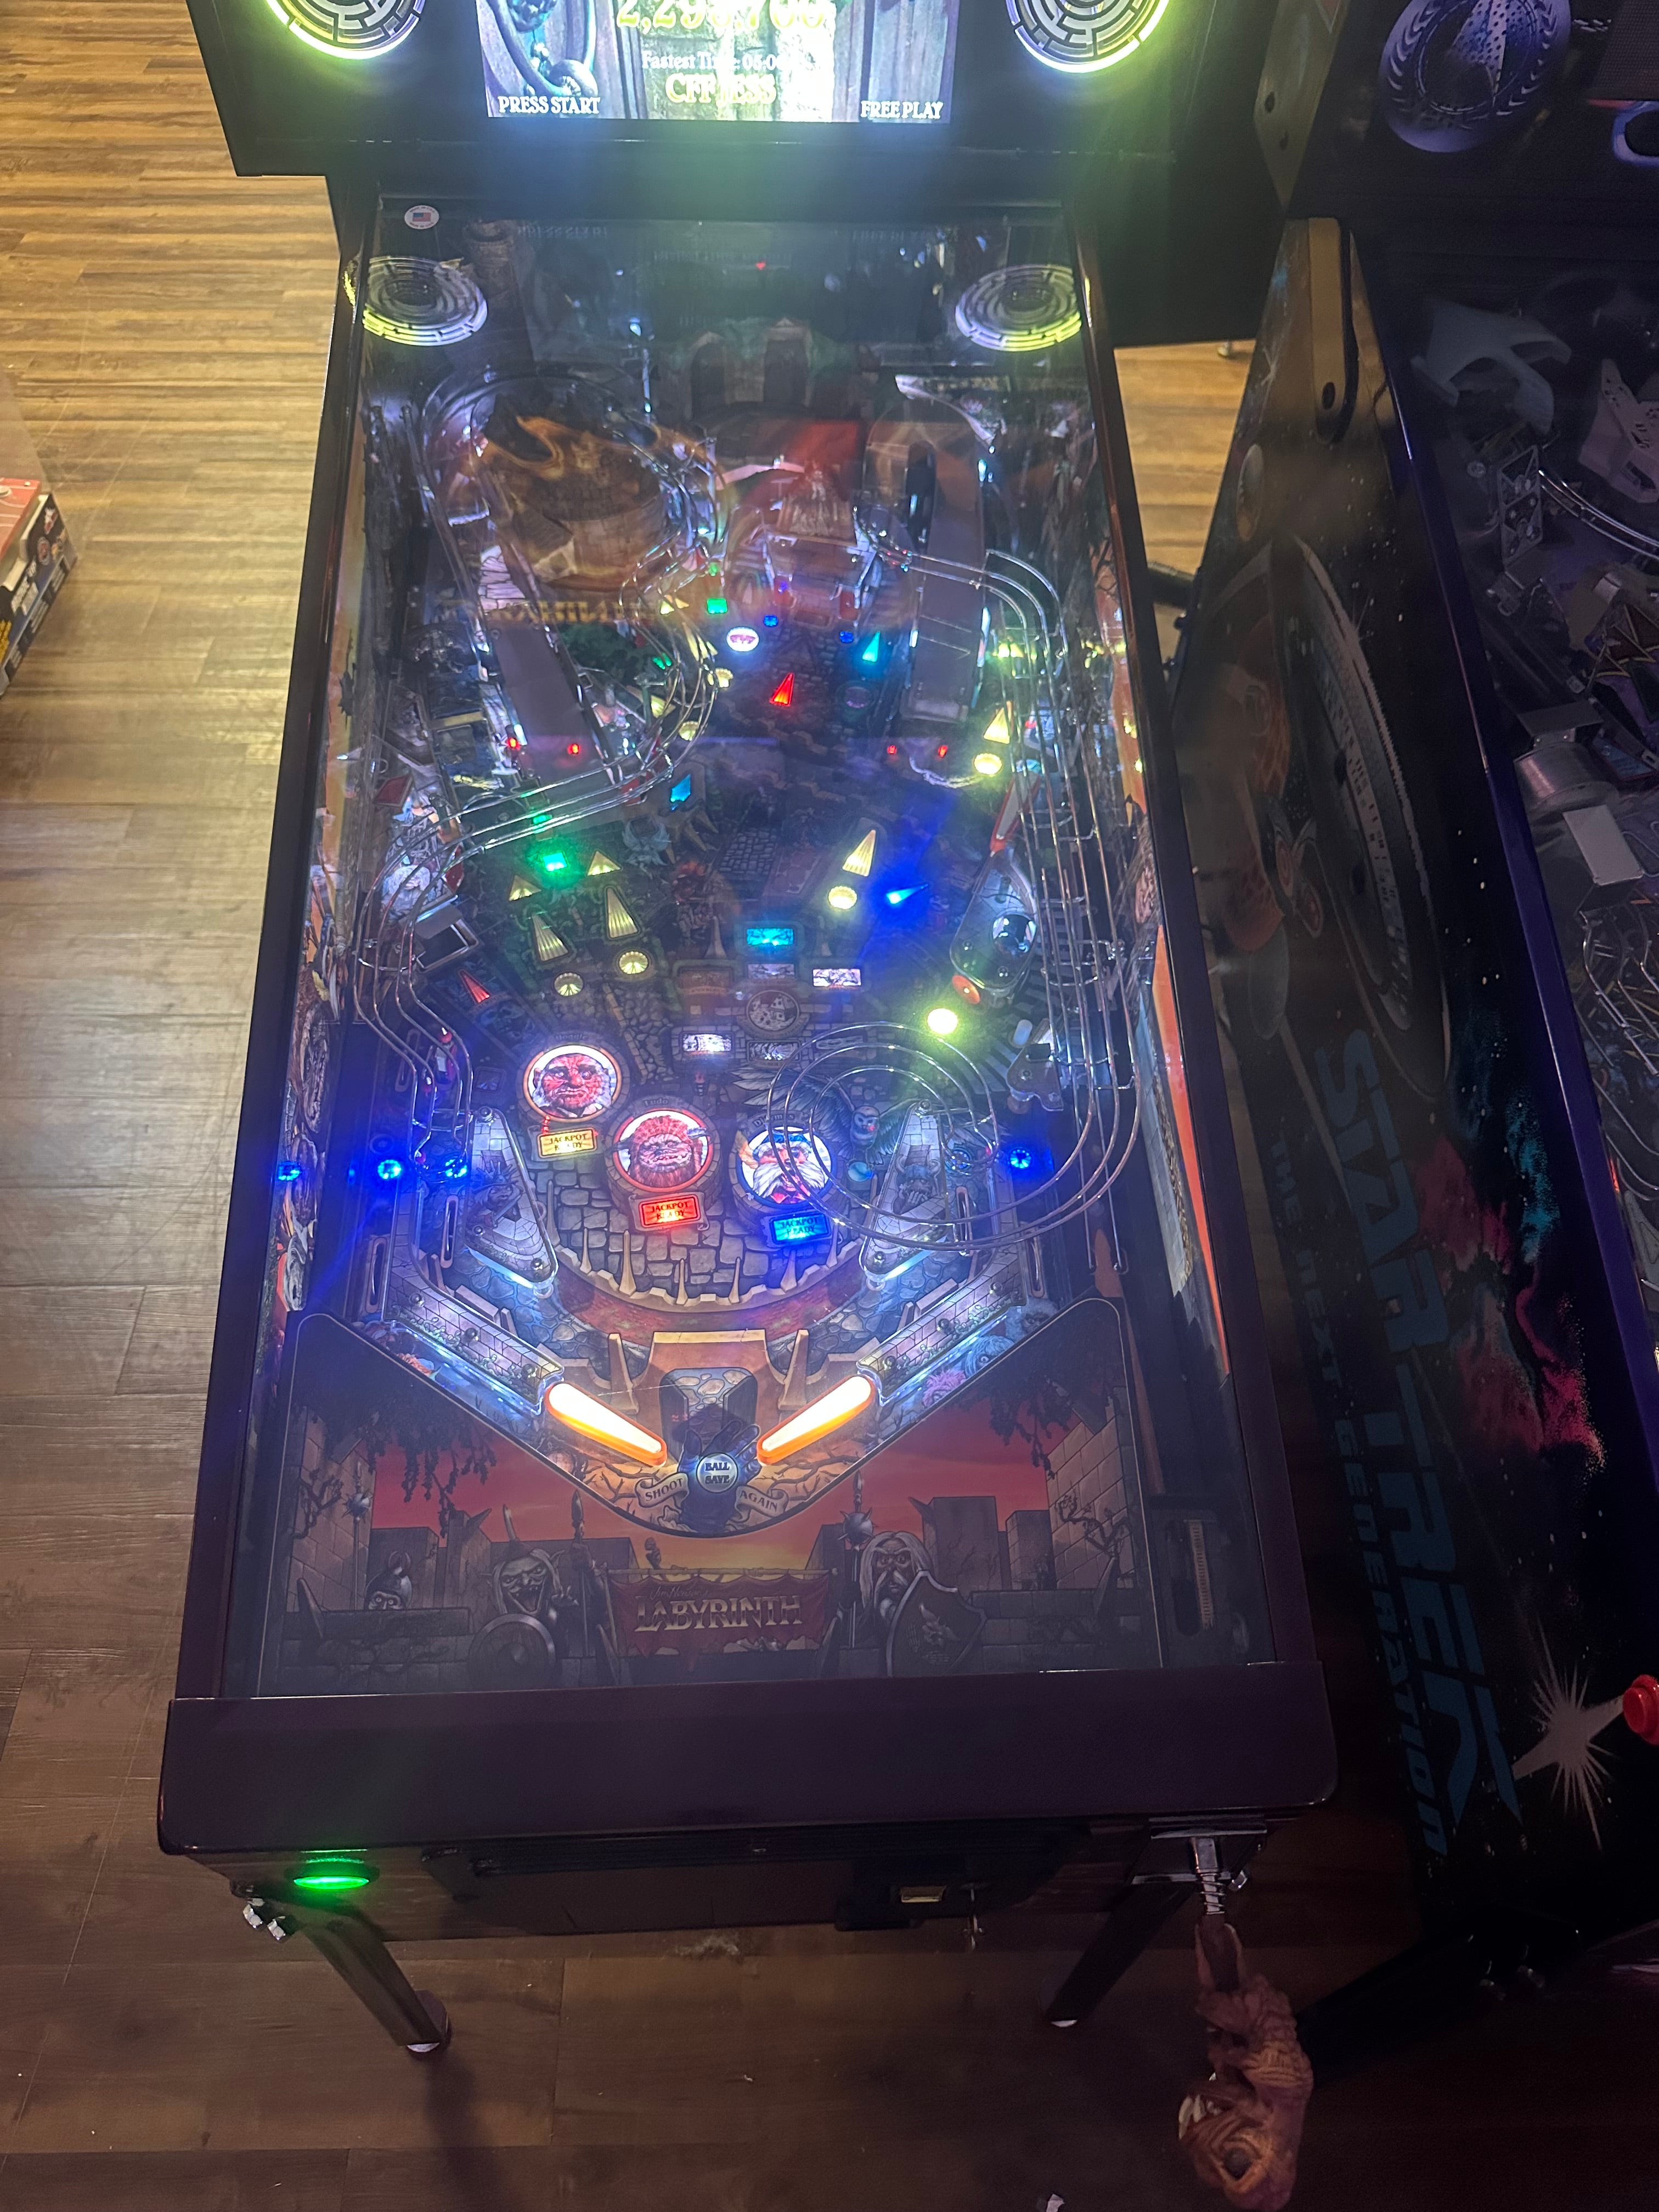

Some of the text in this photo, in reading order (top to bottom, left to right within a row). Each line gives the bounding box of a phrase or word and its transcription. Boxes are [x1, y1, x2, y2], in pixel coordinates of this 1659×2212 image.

[642, 50, 696, 70] Fastest
[665, 72, 777, 108] CFF JESS
[498, 96, 600, 114] PRESS START
[861, 101, 943, 119] FREE PLAY
[549, 1133, 588, 1144] JACKPOT
[1315, 1029, 1449, 1353] STAR
[651, 1201, 690, 1212] JACKPOT
[780, 1217, 817, 1228] JACKPOT
[705, 1462, 730, 1471] BALL
[705, 1475, 730, 1484] SAVE
[645, 1478, 682, 1502] SHOOT
[740, 1490, 778, 1513] AGAIN
[1364, 1363, 1523, 1826] TREK
[634, 1595, 803, 1633] LABYRINTH
